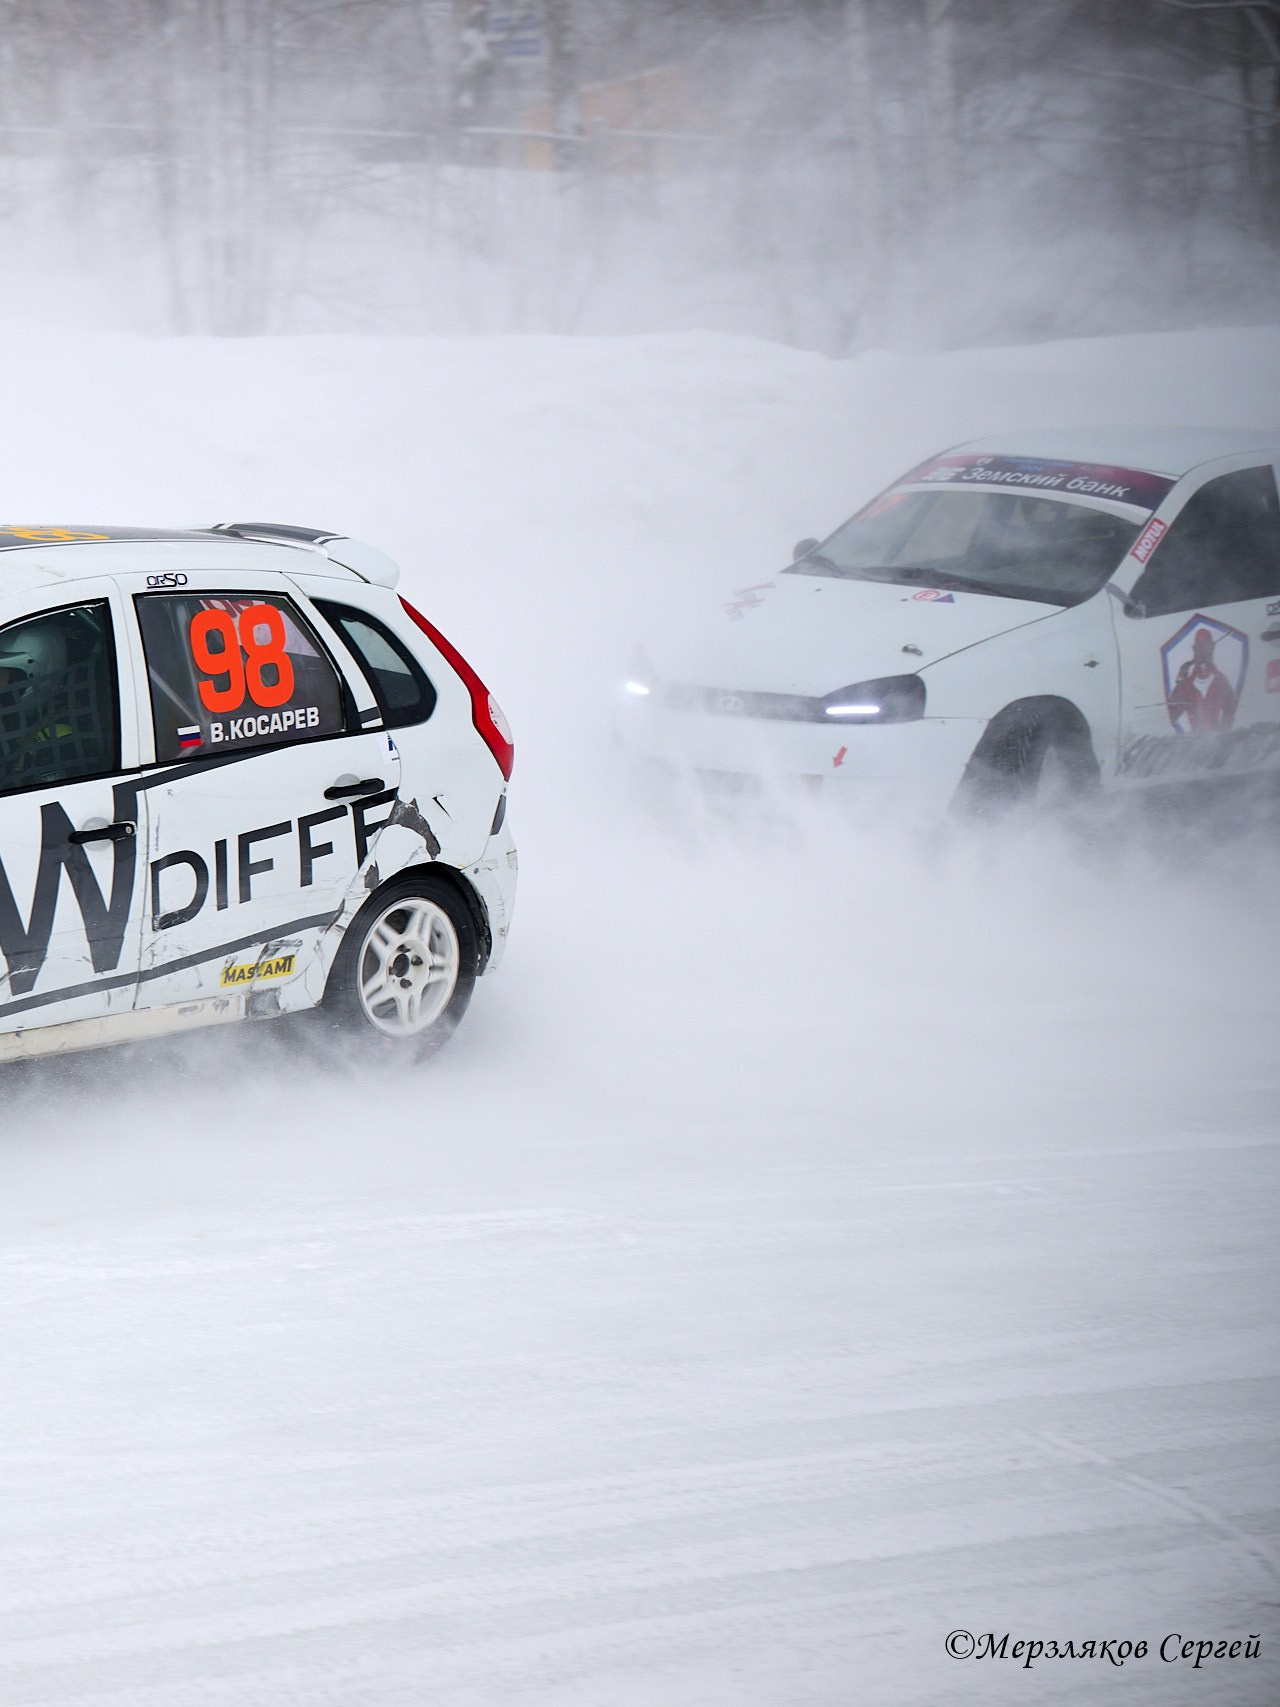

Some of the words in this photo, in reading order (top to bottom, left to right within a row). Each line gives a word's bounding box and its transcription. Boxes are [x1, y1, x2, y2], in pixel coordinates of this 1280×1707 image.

[961, 467, 1066, 488] Земский
[1066, 476, 1131, 498] банк
[1133, 521, 1166, 562] MOTUL
[190, 603, 296, 714] 98
[210, 706, 320, 743] В.КОСАРЕВ
